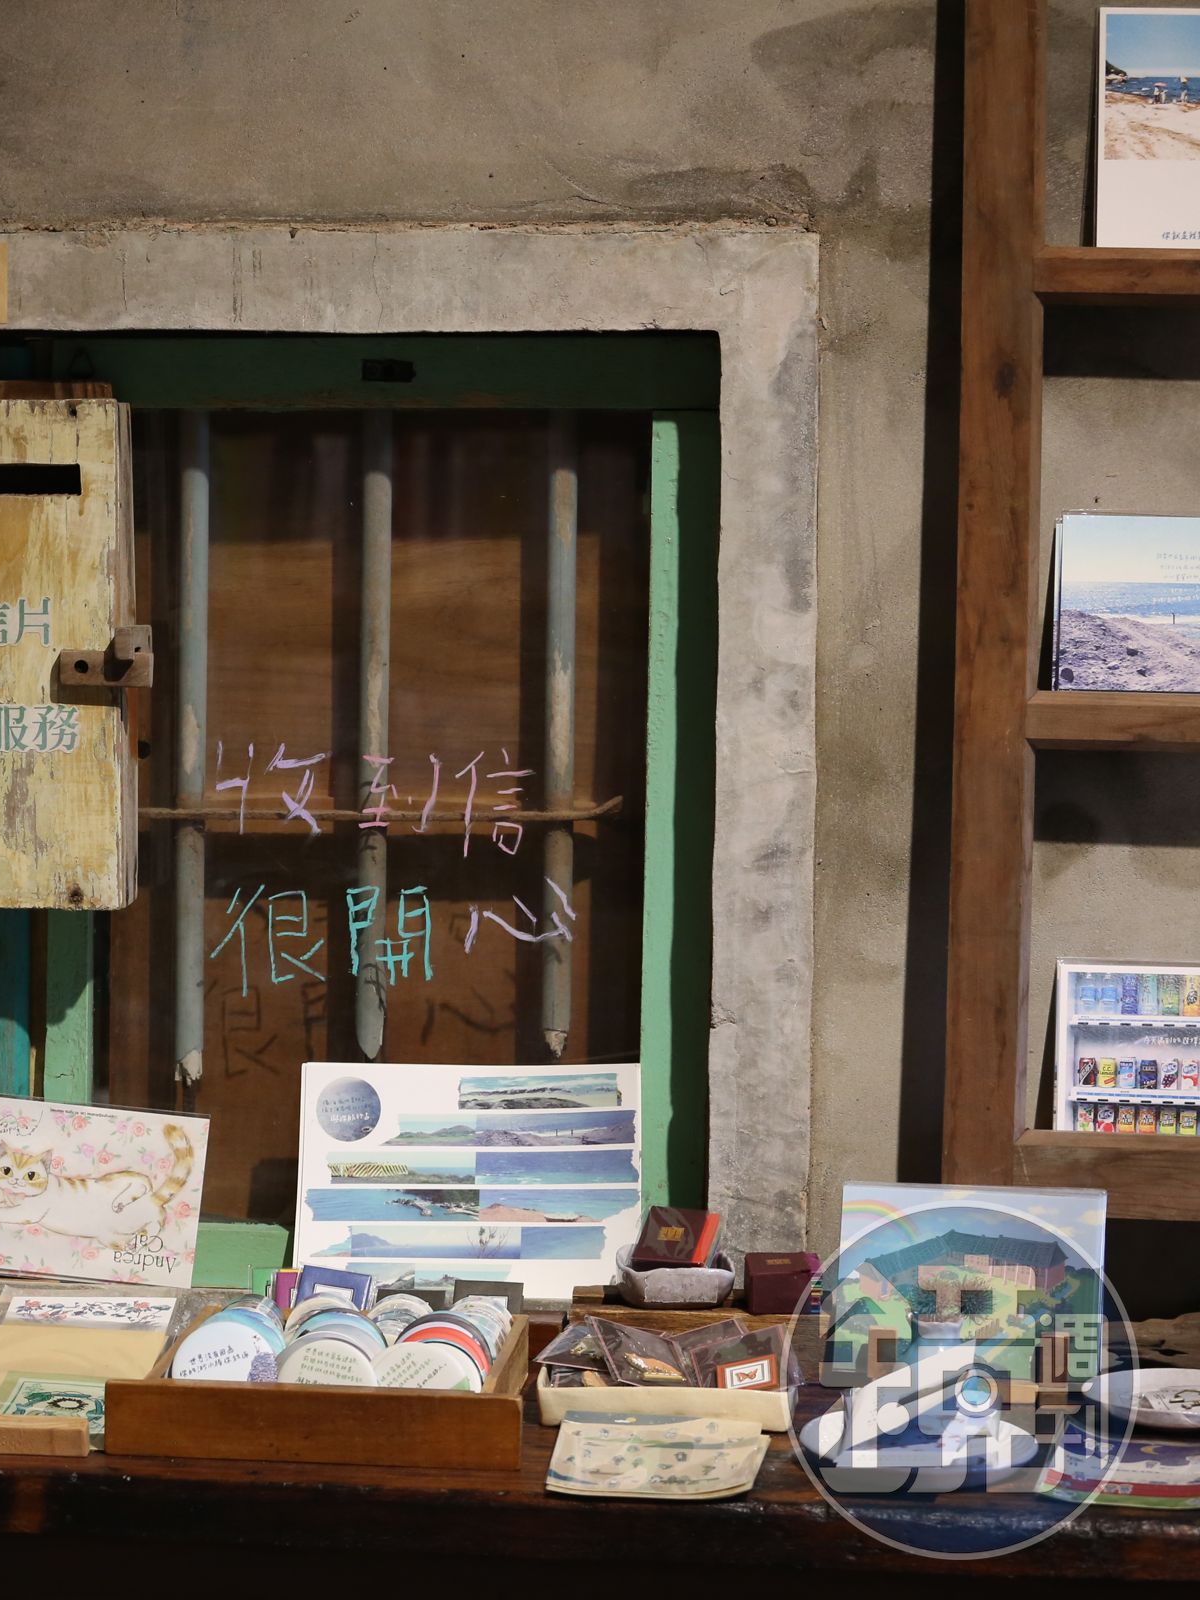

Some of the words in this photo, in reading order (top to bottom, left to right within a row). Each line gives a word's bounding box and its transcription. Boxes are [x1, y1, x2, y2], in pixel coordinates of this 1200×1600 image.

[215, 740, 535, 858] 收到信
[209, 876, 577, 997] 很開心
[113, 1251, 176, 1274] Andrea
[132, 1234, 163, 1253] Cat
